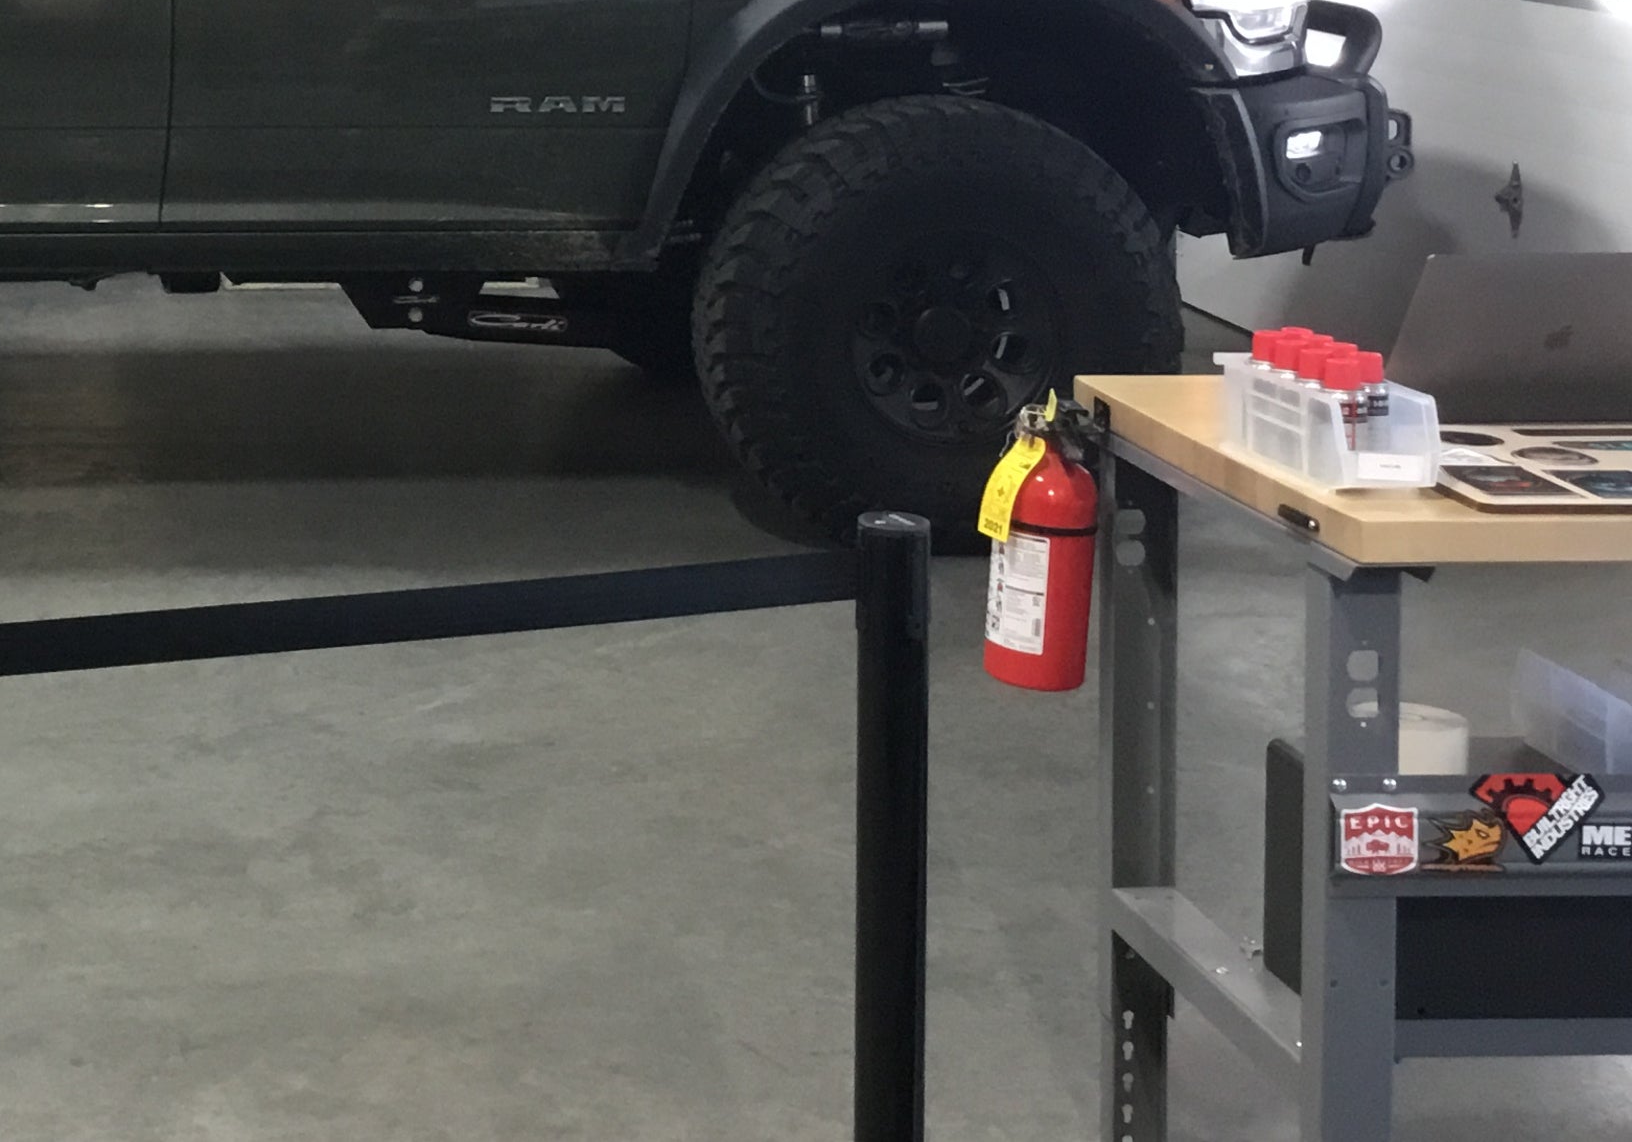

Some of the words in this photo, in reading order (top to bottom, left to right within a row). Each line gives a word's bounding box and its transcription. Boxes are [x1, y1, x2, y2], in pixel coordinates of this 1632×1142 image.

[490, 96, 626, 113] RAM
[1523, 774, 1588, 848] BUILTRIGHT
[1350, 816, 1408, 829] EPIC
[1531, 786, 1599, 859] INDUSTRIES
[1581, 846, 1632, 857] RACE
